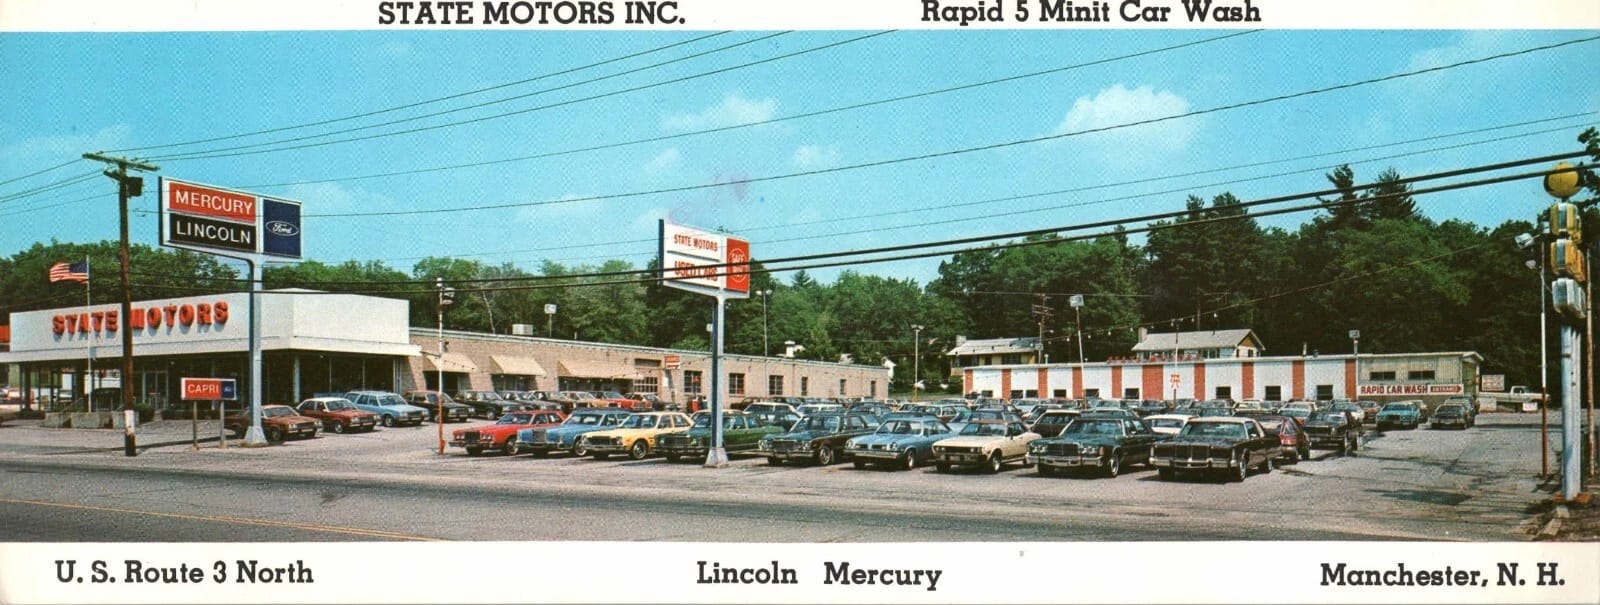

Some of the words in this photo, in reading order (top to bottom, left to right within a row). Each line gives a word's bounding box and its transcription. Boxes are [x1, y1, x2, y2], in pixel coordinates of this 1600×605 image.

[175, 190, 253, 214] MERCURY
[176, 220, 251, 244] LINCOLN
[272, 222, 292, 235] Ford
[674, 234, 692, 246] STATE
[693, 238, 718, 251] MOTORS
[52, 310, 118, 336] STATE
[130, 301, 228, 330] MOTORS
[187, 383, 219, 393] CAPRI
[1360, 385, 1385, 394] RAPID
[1386, 385, 1403, 394] CAR
[1404, 385, 1427, 394] WASH
